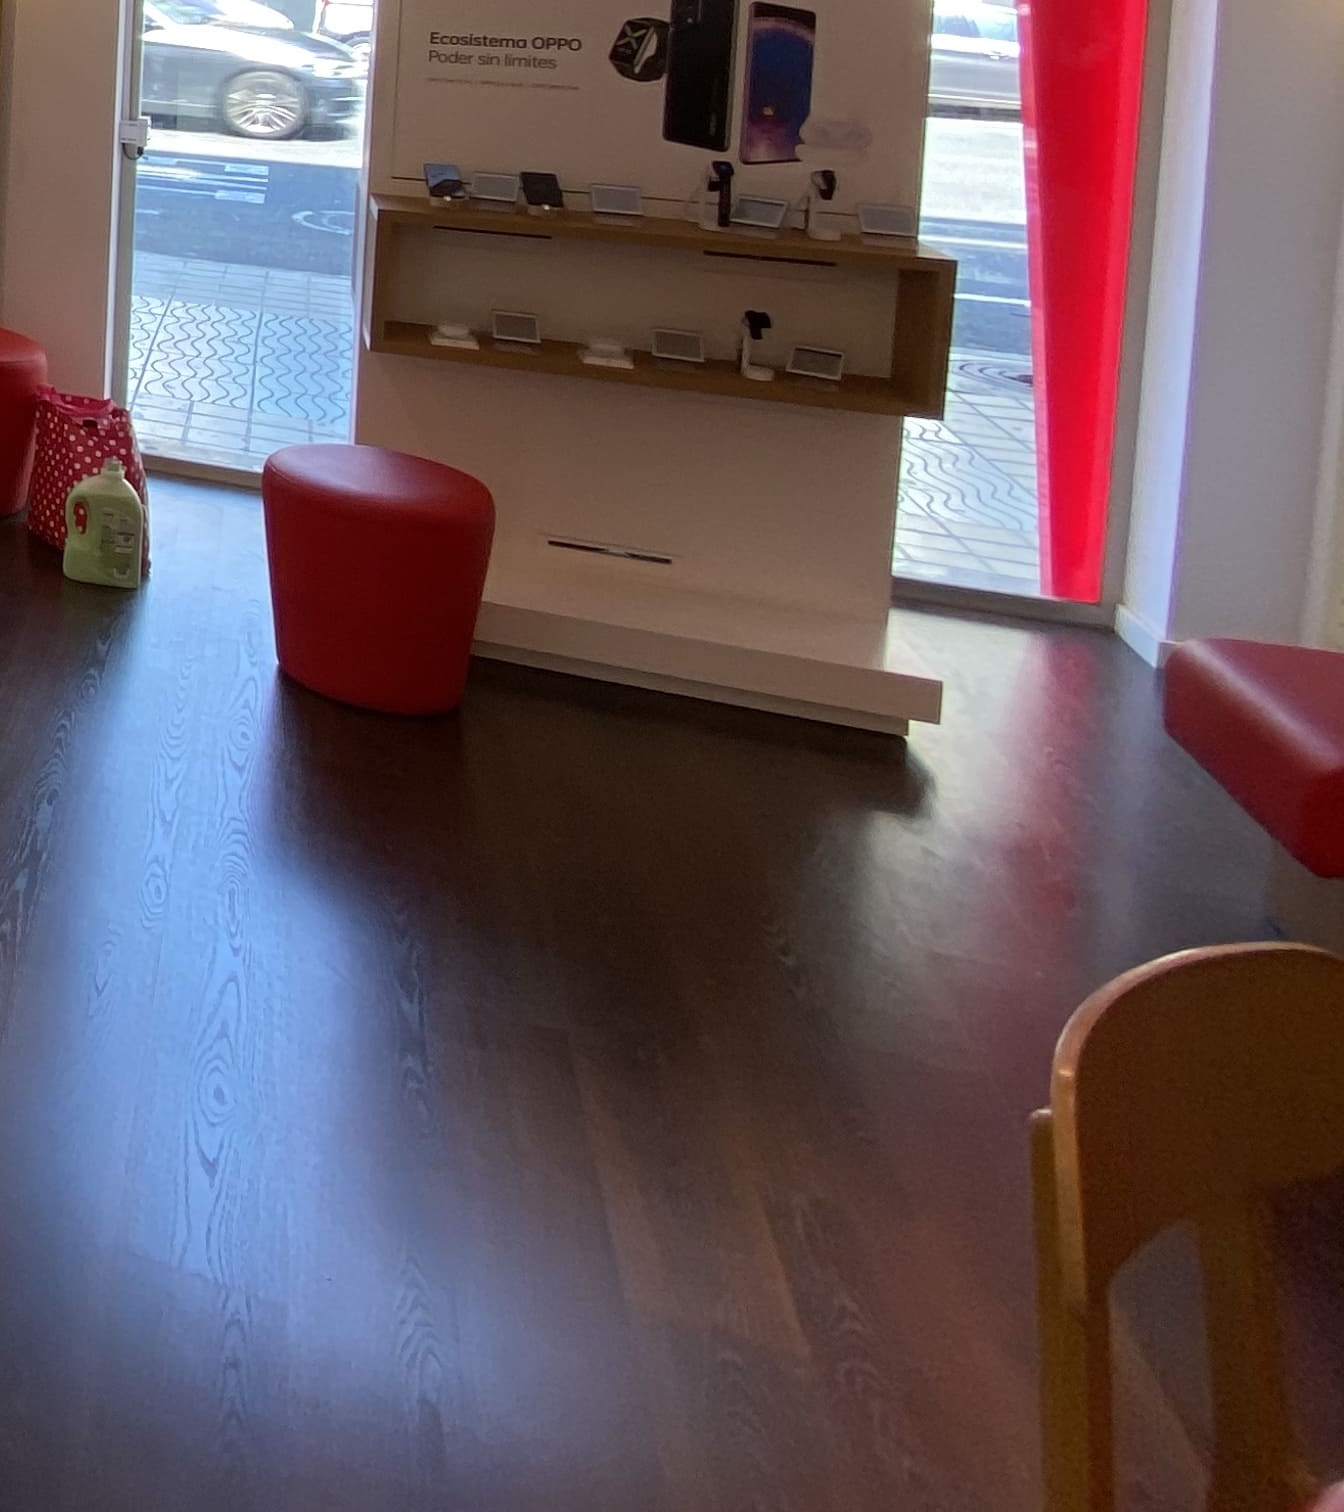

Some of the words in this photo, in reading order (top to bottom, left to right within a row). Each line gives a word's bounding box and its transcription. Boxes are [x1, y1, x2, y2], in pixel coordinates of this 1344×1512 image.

[430, 31, 528, 49] Ecosistema
[531, 36, 583, 52] OPPO
[428, 49, 474, 65] Poder
[477, 53, 500, 67] sin
